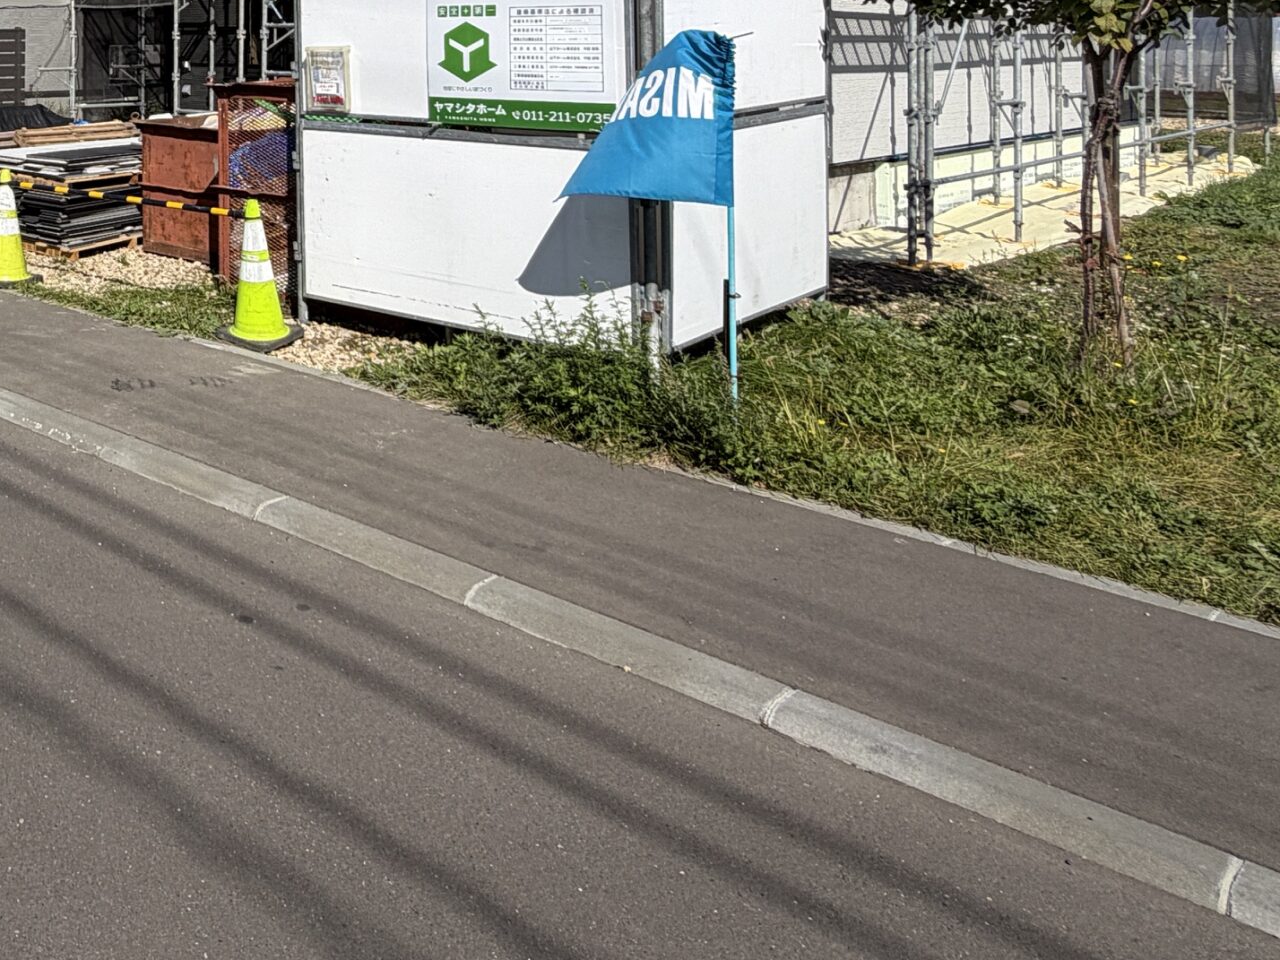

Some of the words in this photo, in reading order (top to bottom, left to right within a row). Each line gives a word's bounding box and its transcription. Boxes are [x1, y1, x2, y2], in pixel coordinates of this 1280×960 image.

[433, 101, 507, 116] ヤマシタホーム
[522, 109, 612, 124] 011-211-0735
